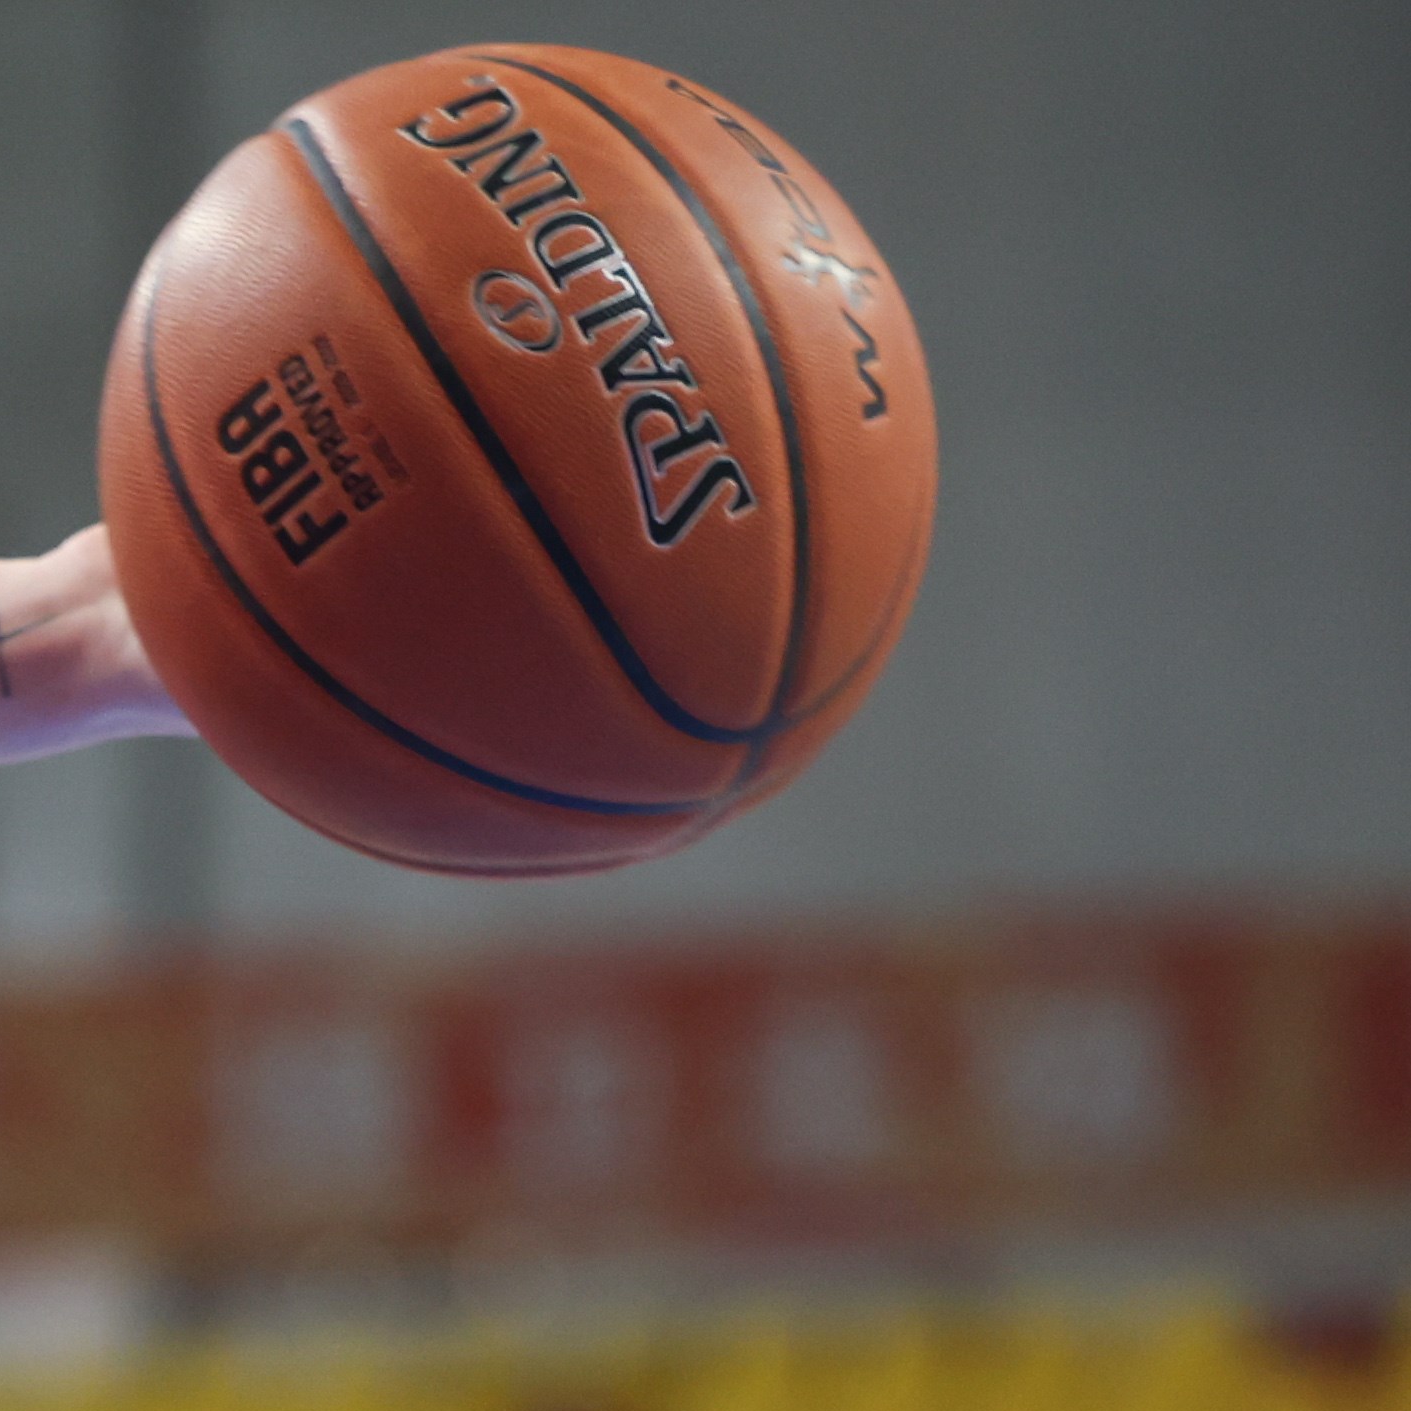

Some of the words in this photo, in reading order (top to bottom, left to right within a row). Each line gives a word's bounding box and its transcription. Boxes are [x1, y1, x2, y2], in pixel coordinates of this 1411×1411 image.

[397, 74, 758, 548] SPALDING
[218, 378, 350, 567] FIBA
[280, 354, 384, 512] APPROVED
